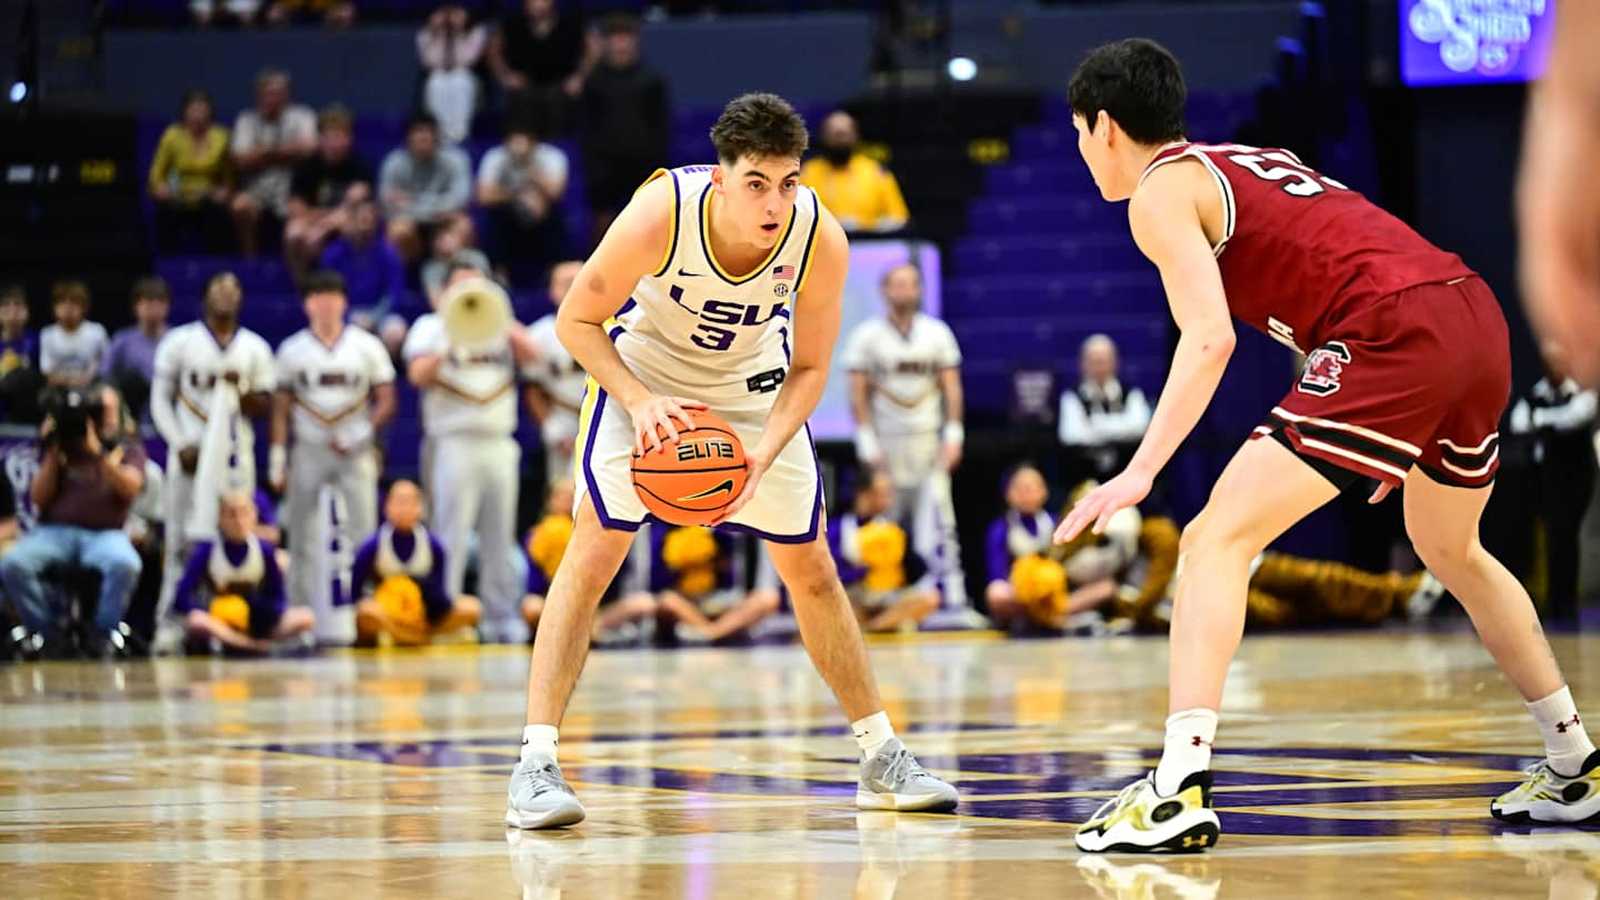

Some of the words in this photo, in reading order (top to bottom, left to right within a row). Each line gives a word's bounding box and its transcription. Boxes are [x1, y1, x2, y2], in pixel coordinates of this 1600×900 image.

[669, 284, 786, 326] LSU
[690, 323, 737, 351] 3
[676, 441, 735, 462] ELITE
